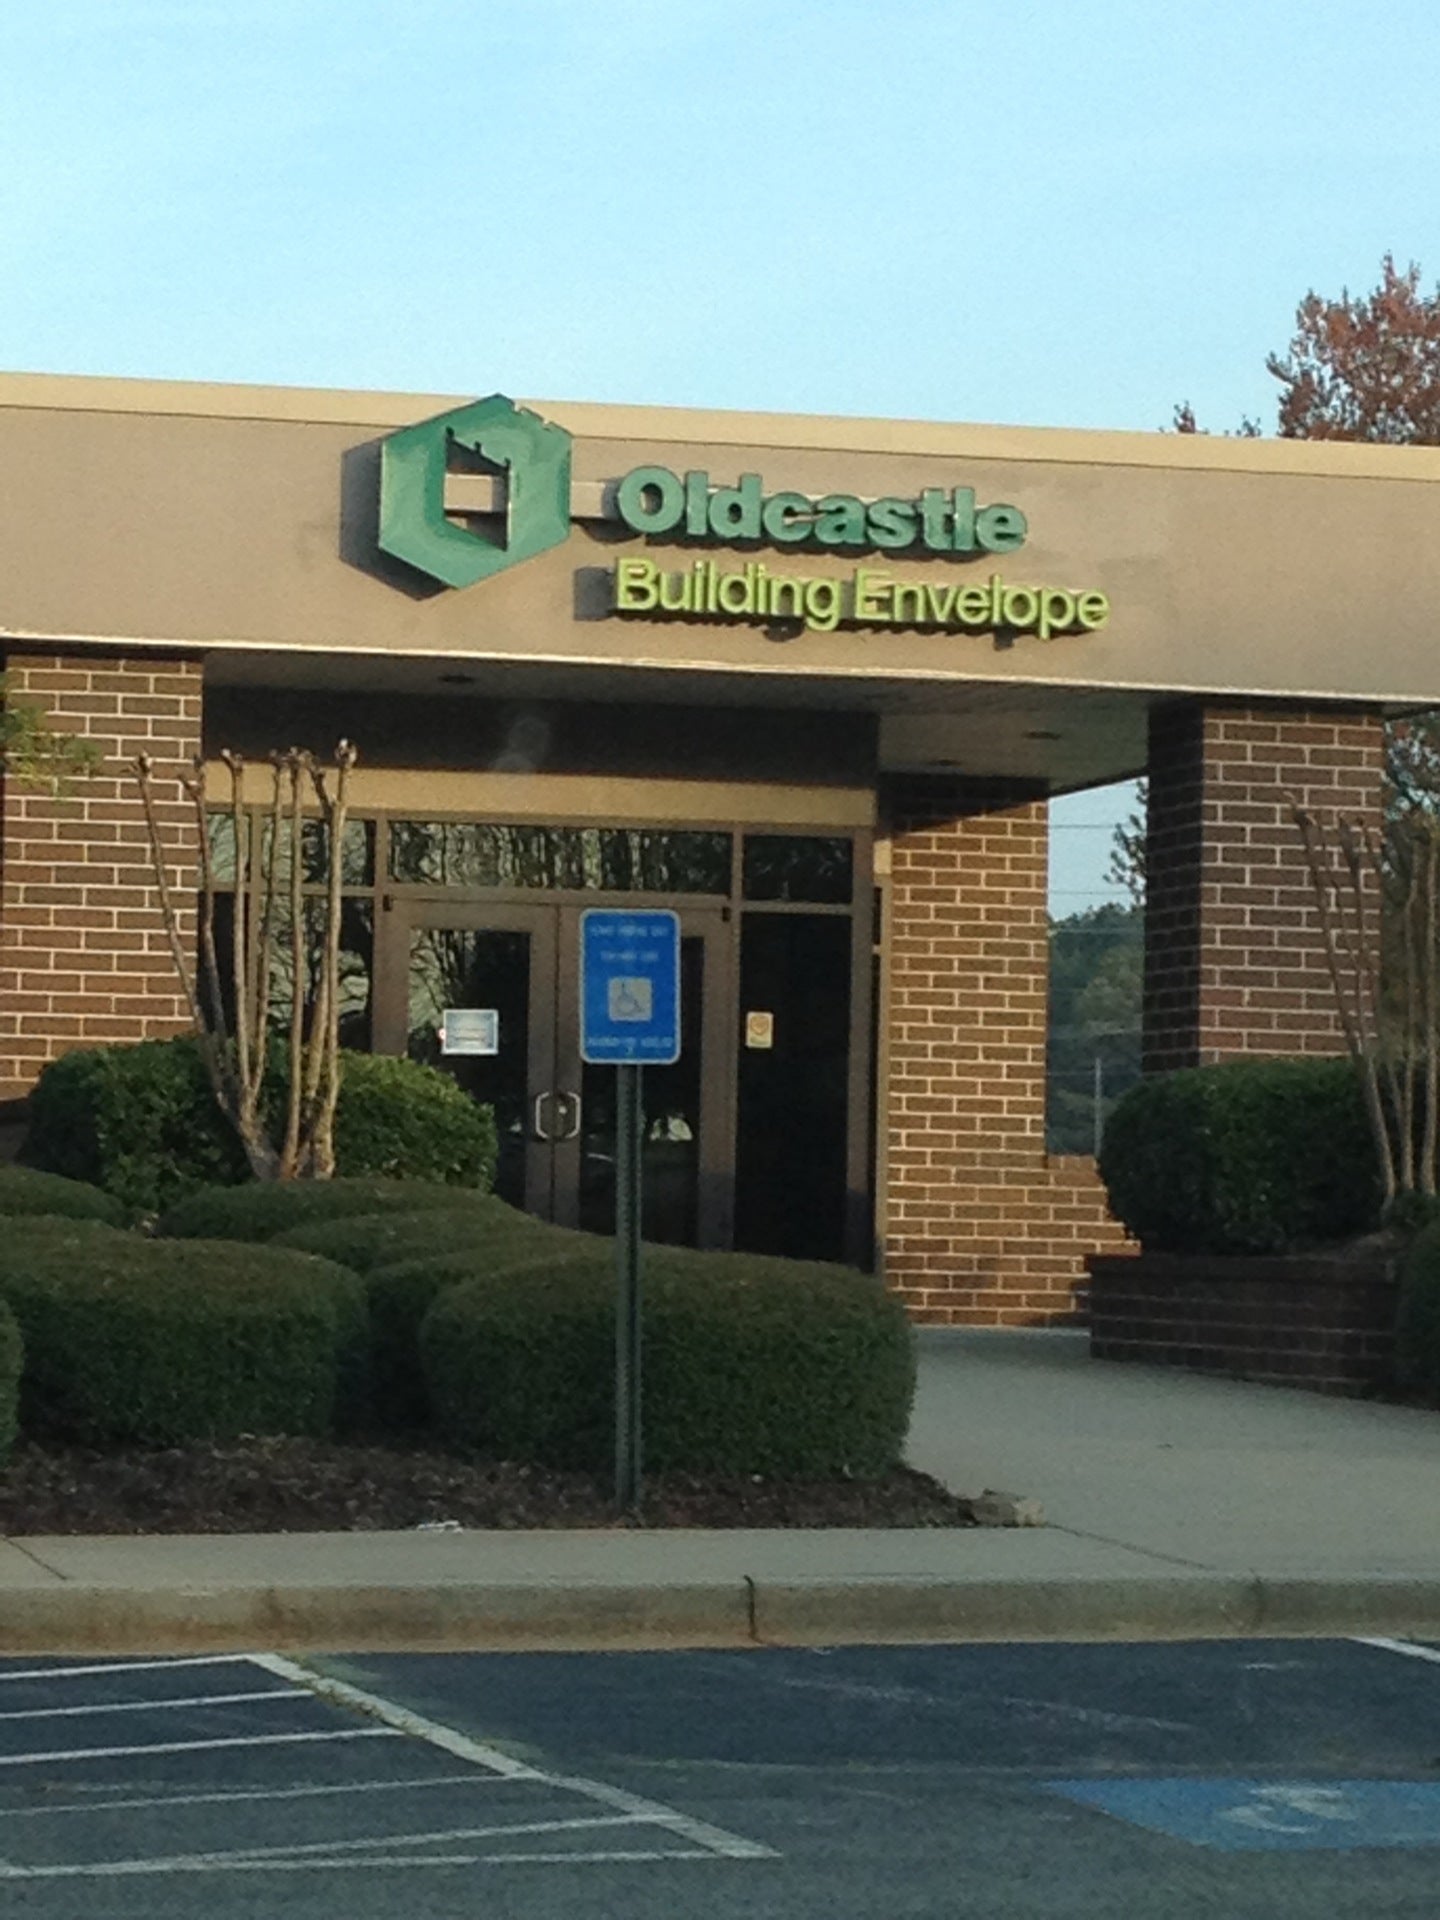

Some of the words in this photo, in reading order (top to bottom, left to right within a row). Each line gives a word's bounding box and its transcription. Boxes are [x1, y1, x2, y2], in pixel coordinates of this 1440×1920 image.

[617, 466, 1027, 552] Oldcastle
[616, 558, 840, 631] Building
[854, 568, 1110, 639] Envelope
